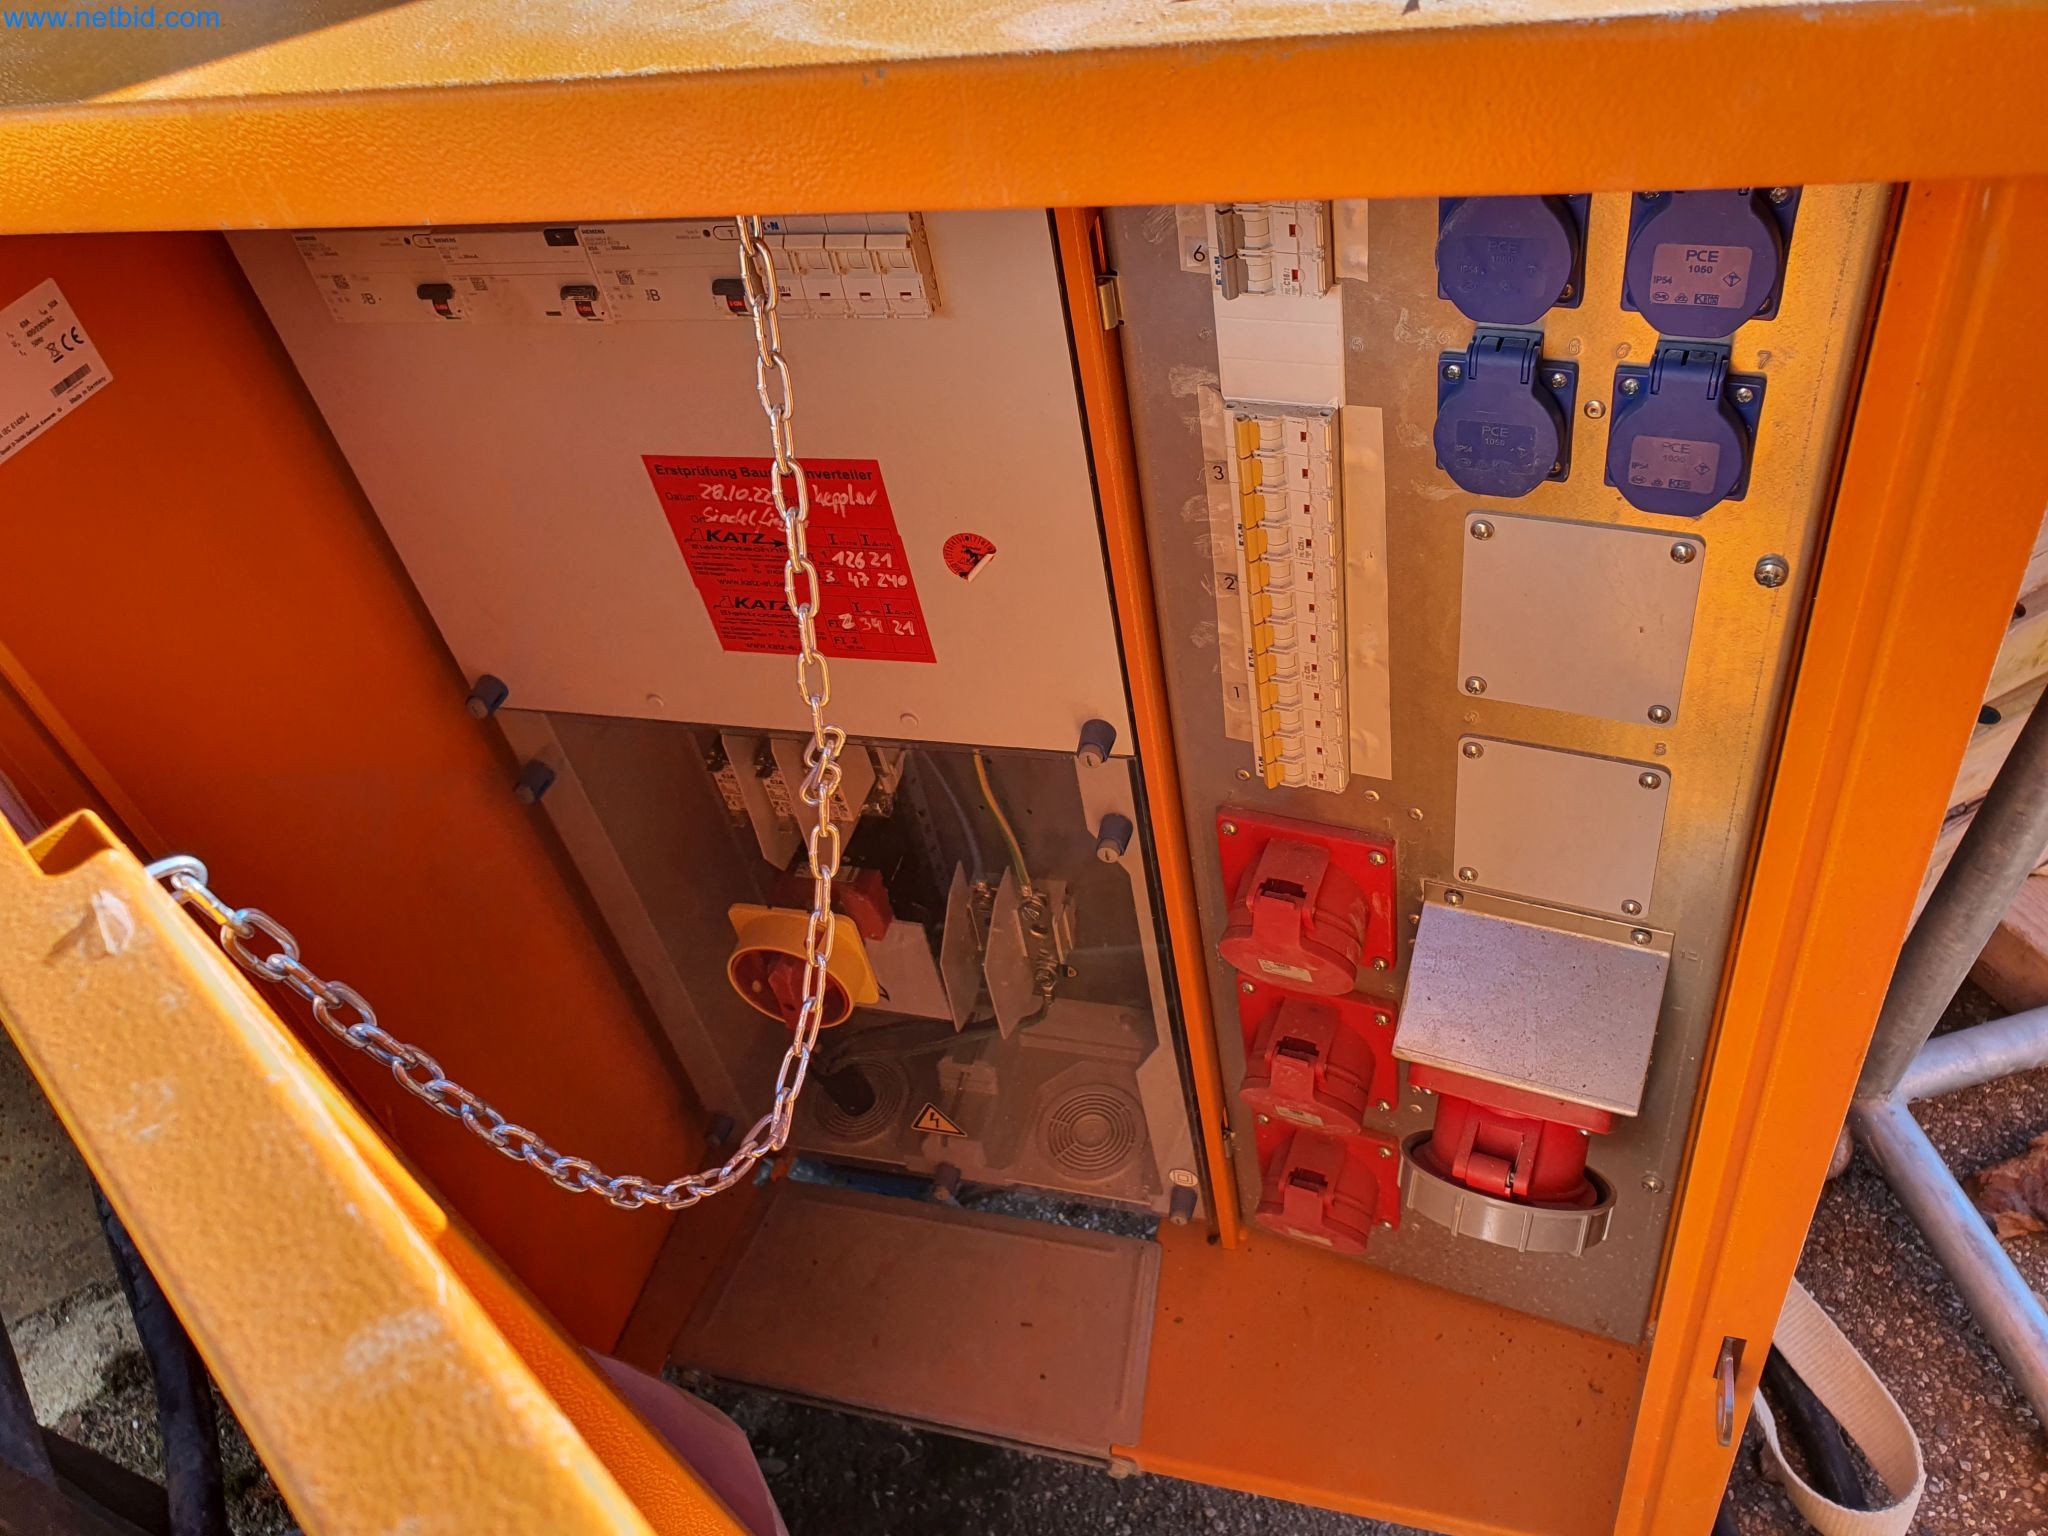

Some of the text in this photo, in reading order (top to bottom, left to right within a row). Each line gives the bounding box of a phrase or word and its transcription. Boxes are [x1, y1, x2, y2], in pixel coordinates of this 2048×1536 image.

[1193, 245, 1206, 262] 6
[1685, 249, 1720, 263] PCE
[1653, 275, 1673, 284] IP54
[1482, 426, 1509, 437] PCE
[1663, 442, 1691, 455] PCE
[654, 465, 738, 480] Erstprüfung
[1212, 465, 1225, 480] 3
[706, 529, 766, 544] KATZ
[832, 550, 866, 569] 126
[869, 551, 892, 568] 21
[825, 570, 908, 588] 3 47 240
[1224, 576, 1236, 590] 2
[860, 617, 883, 633] 34
[893, 620, 915, 635] 21
[1233, 686, 1240, 698] 1
